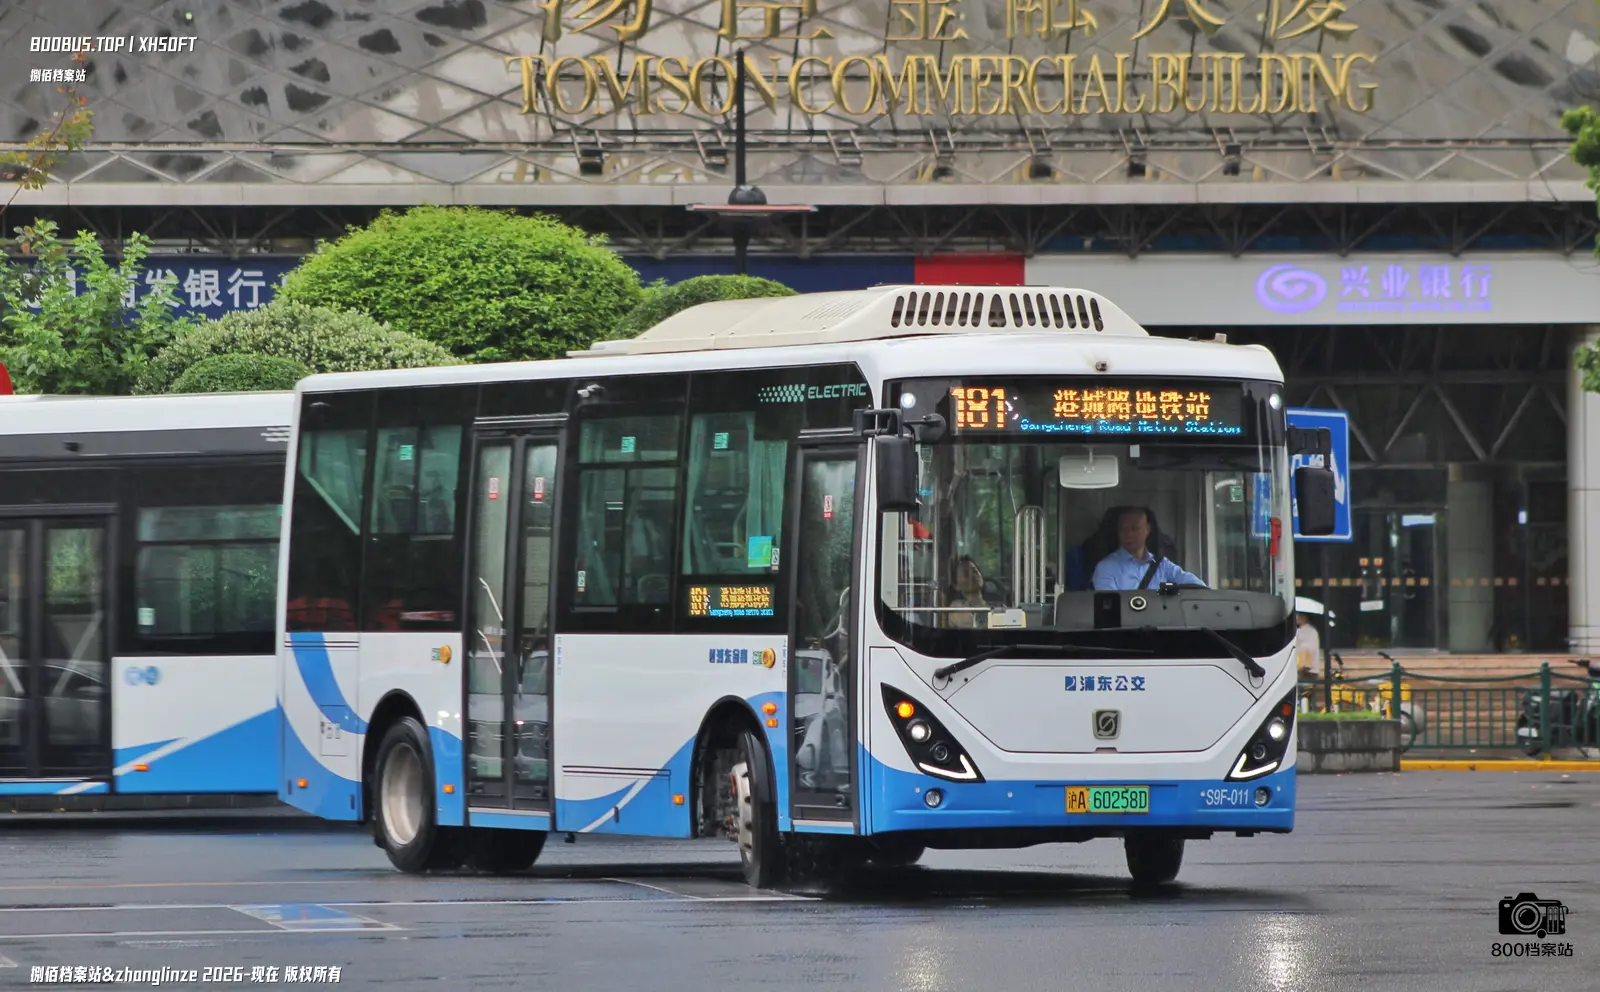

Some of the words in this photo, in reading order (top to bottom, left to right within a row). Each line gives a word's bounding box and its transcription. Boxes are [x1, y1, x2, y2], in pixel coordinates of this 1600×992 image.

[505, 55, 782, 116] TOMSON
[787, 53, 1146, 116] COMMERCIAL
[1147, 52, 1379, 115] BUILDING
[1337, 264, 1493, 299] 兴业银行
[808, 383, 867, 399] ELECTRIC
[951, 388, 1005, 428] 181
[1080, 675, 1146, 691] 浦东公交
[1205, 788, 1249, 806] S9F-011
